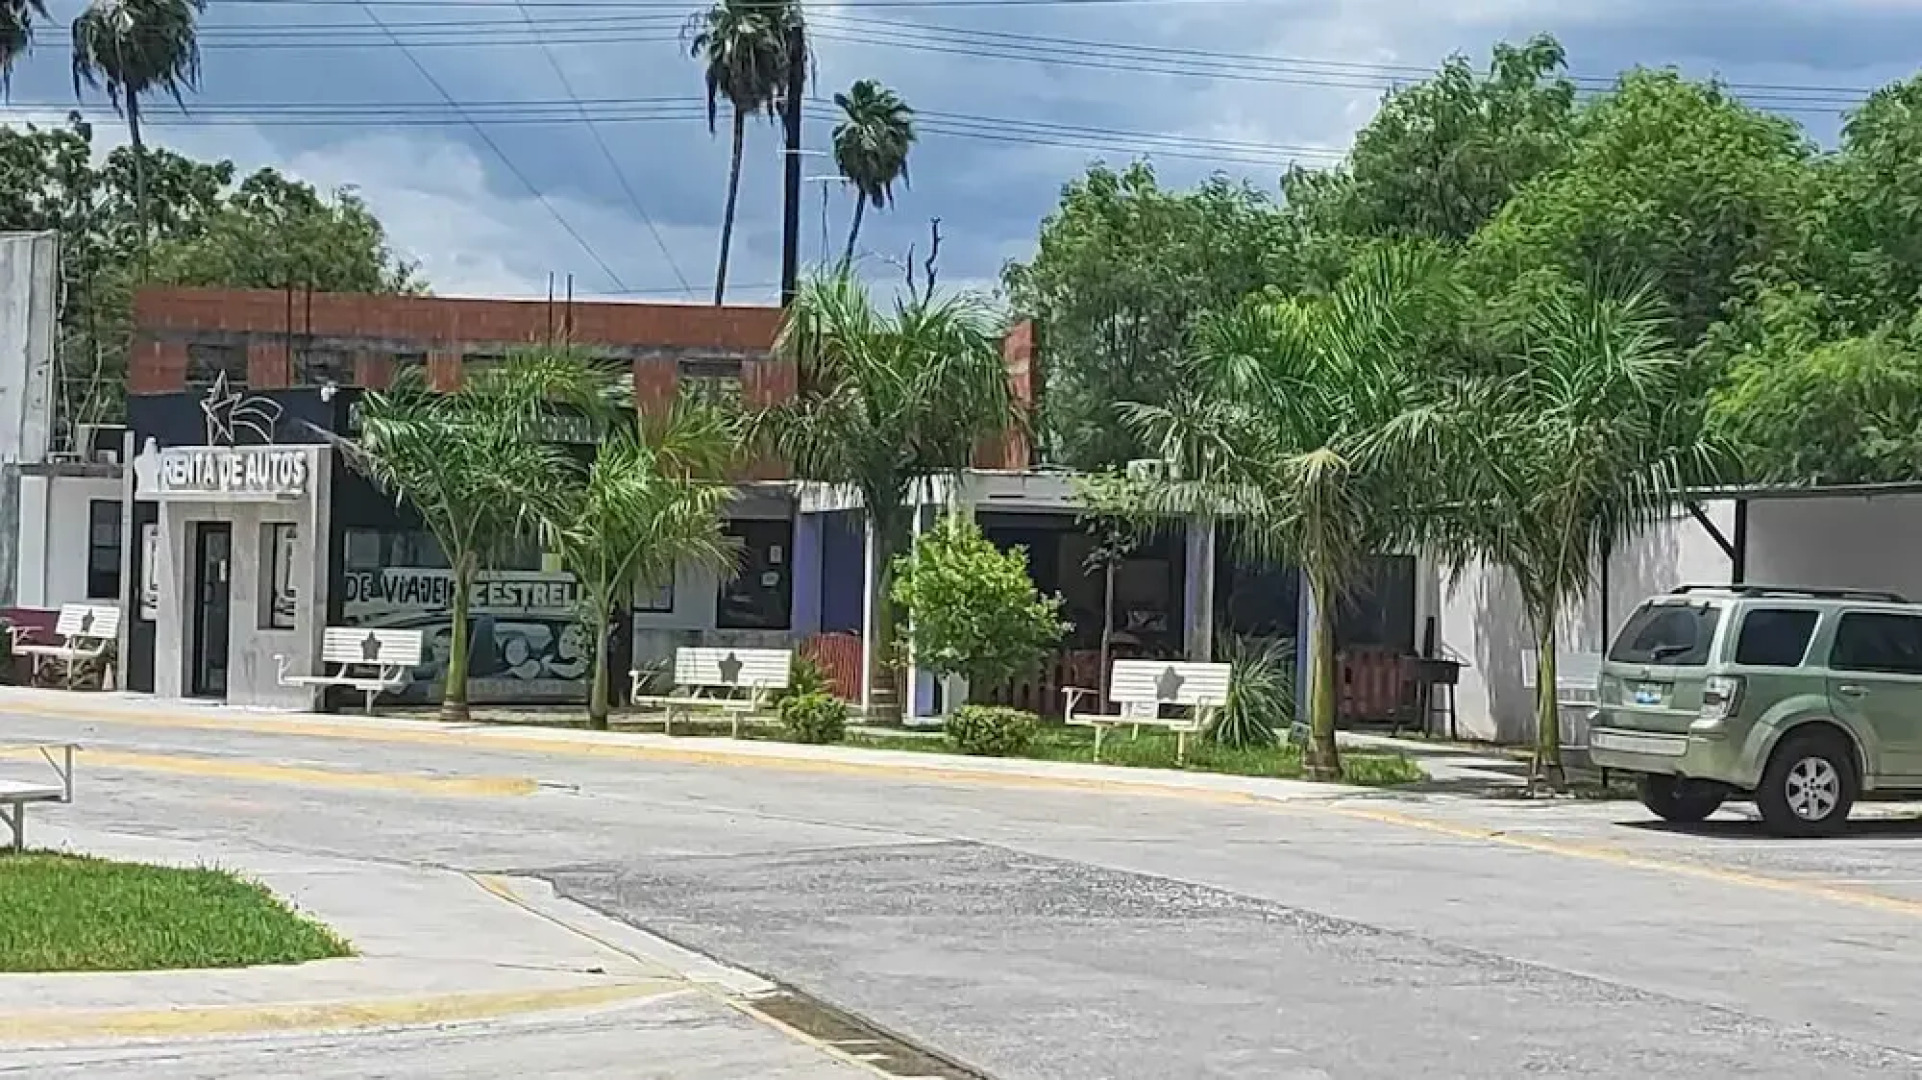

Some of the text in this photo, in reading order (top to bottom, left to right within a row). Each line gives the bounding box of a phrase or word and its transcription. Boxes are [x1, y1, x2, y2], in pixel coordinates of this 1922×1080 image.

[162, 451, 308, 488] RENTA DE AUTOS
[344, 573, 371, 602] DE
